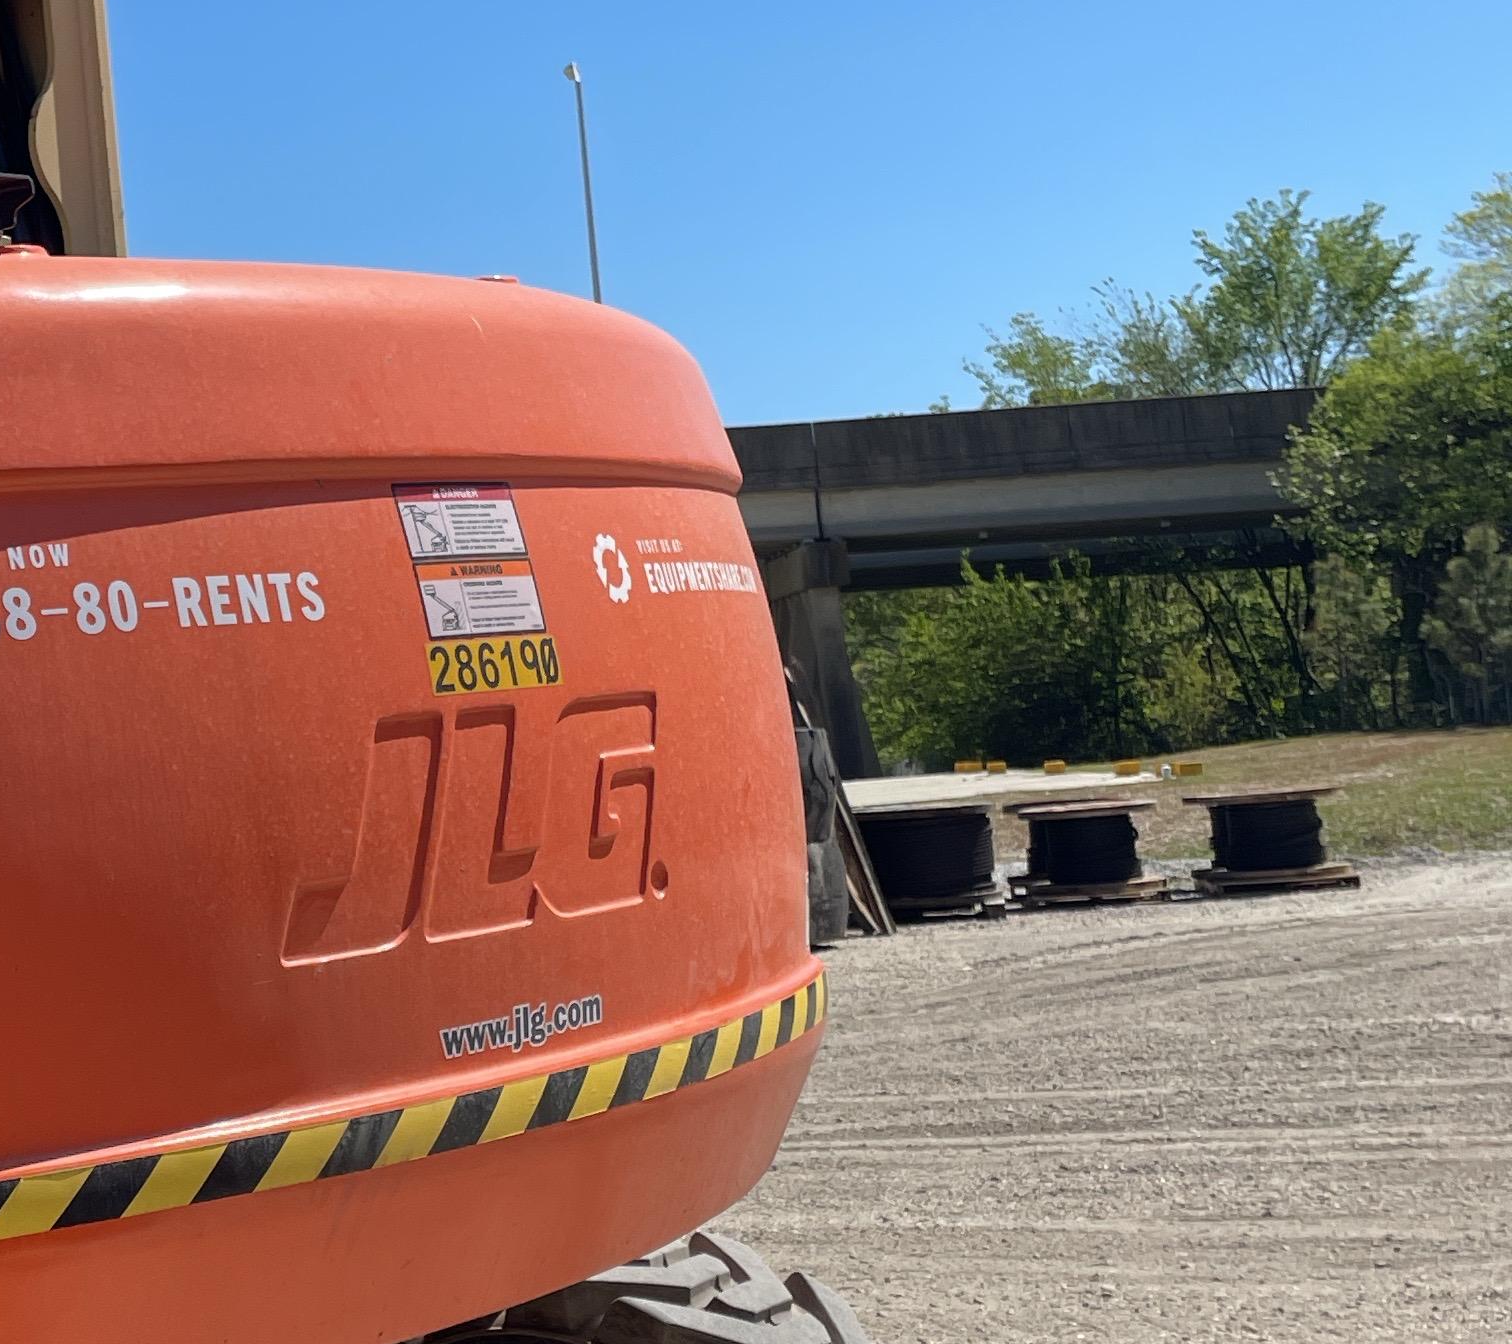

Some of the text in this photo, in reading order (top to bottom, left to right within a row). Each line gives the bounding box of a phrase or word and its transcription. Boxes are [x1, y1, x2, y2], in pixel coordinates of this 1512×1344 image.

[7, 542, 70, 570] NOW
[460, 563, 503, 576] WARNING
[429, 637, 559, 694] 286190
[439, 993, 603, 1060] www.jlg.com
